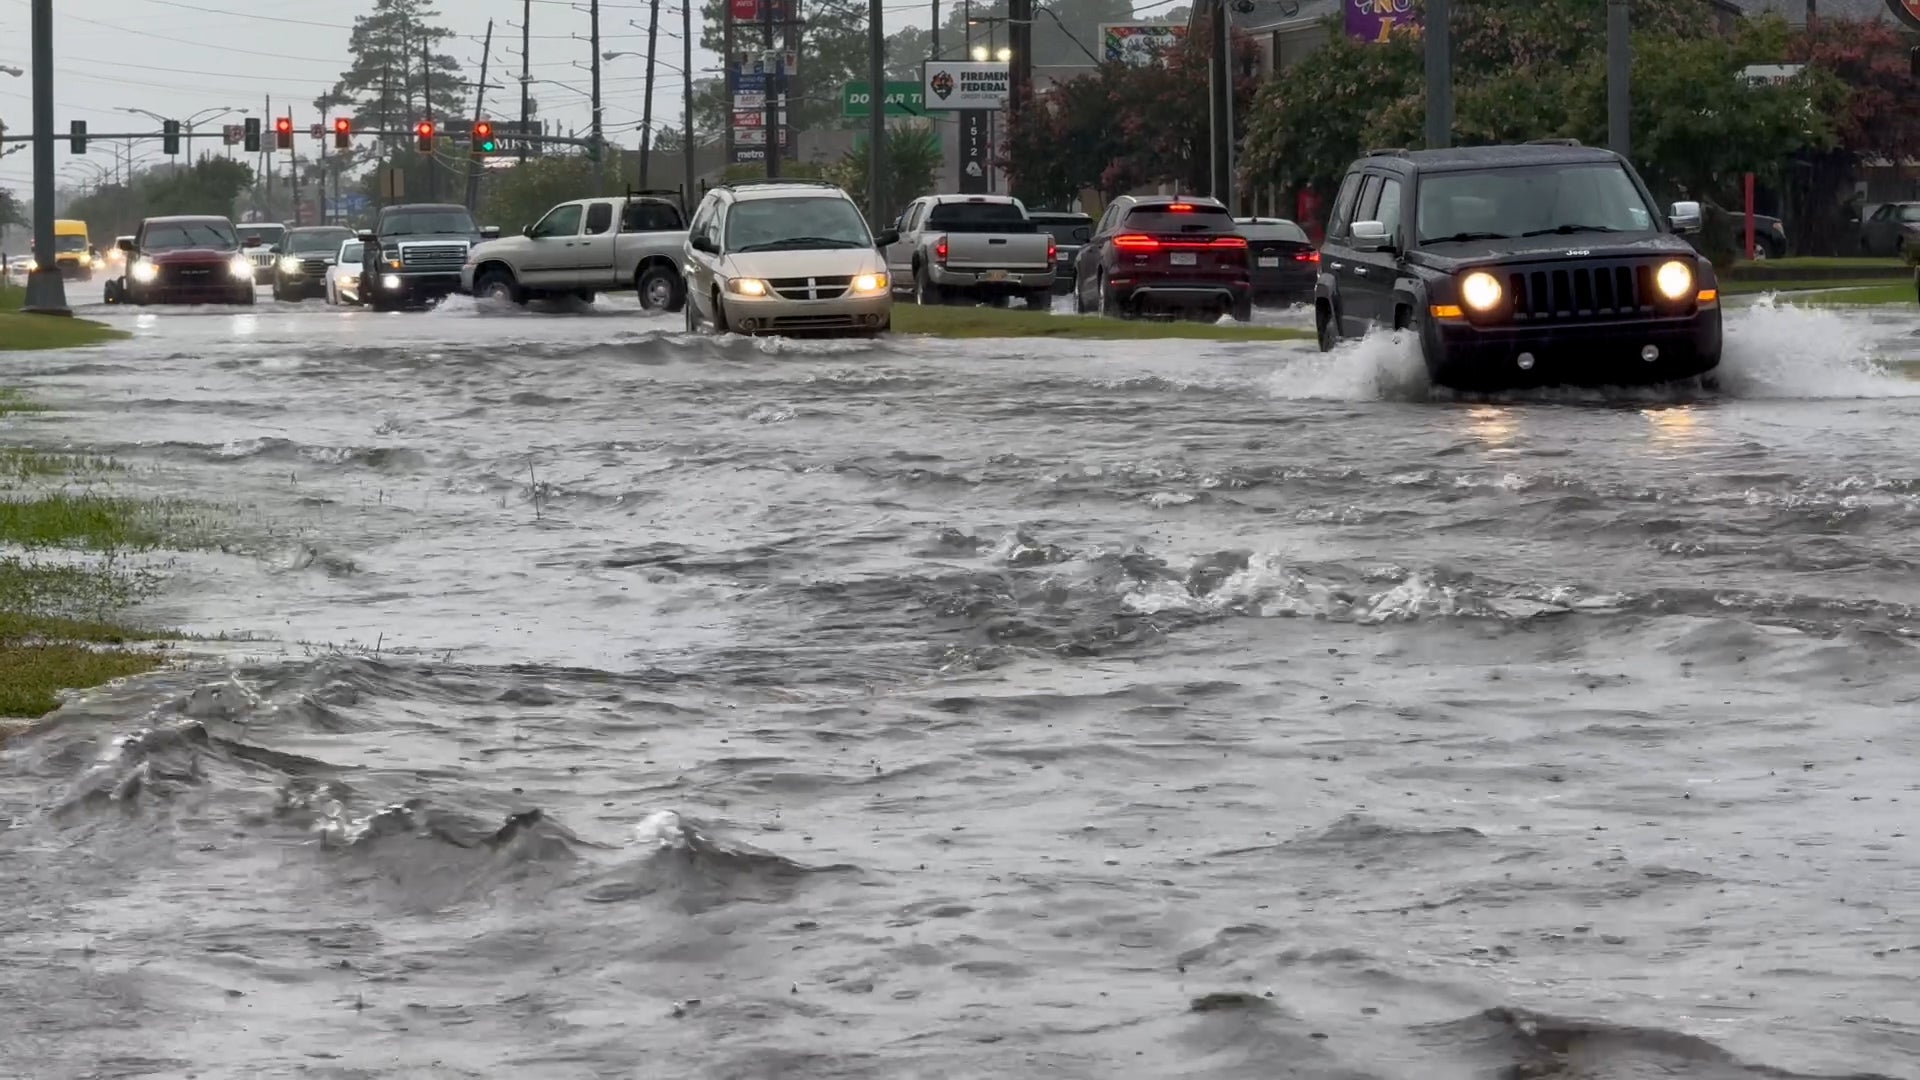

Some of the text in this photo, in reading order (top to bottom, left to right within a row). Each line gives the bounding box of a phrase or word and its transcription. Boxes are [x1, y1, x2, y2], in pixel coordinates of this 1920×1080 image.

[960, 71, 1008, 81] FIREMEN
[960, 82, 1007, 92] FEDERAL
[849, 93, 905, 104] DOAR
[737, 149, 765, 158] metro
